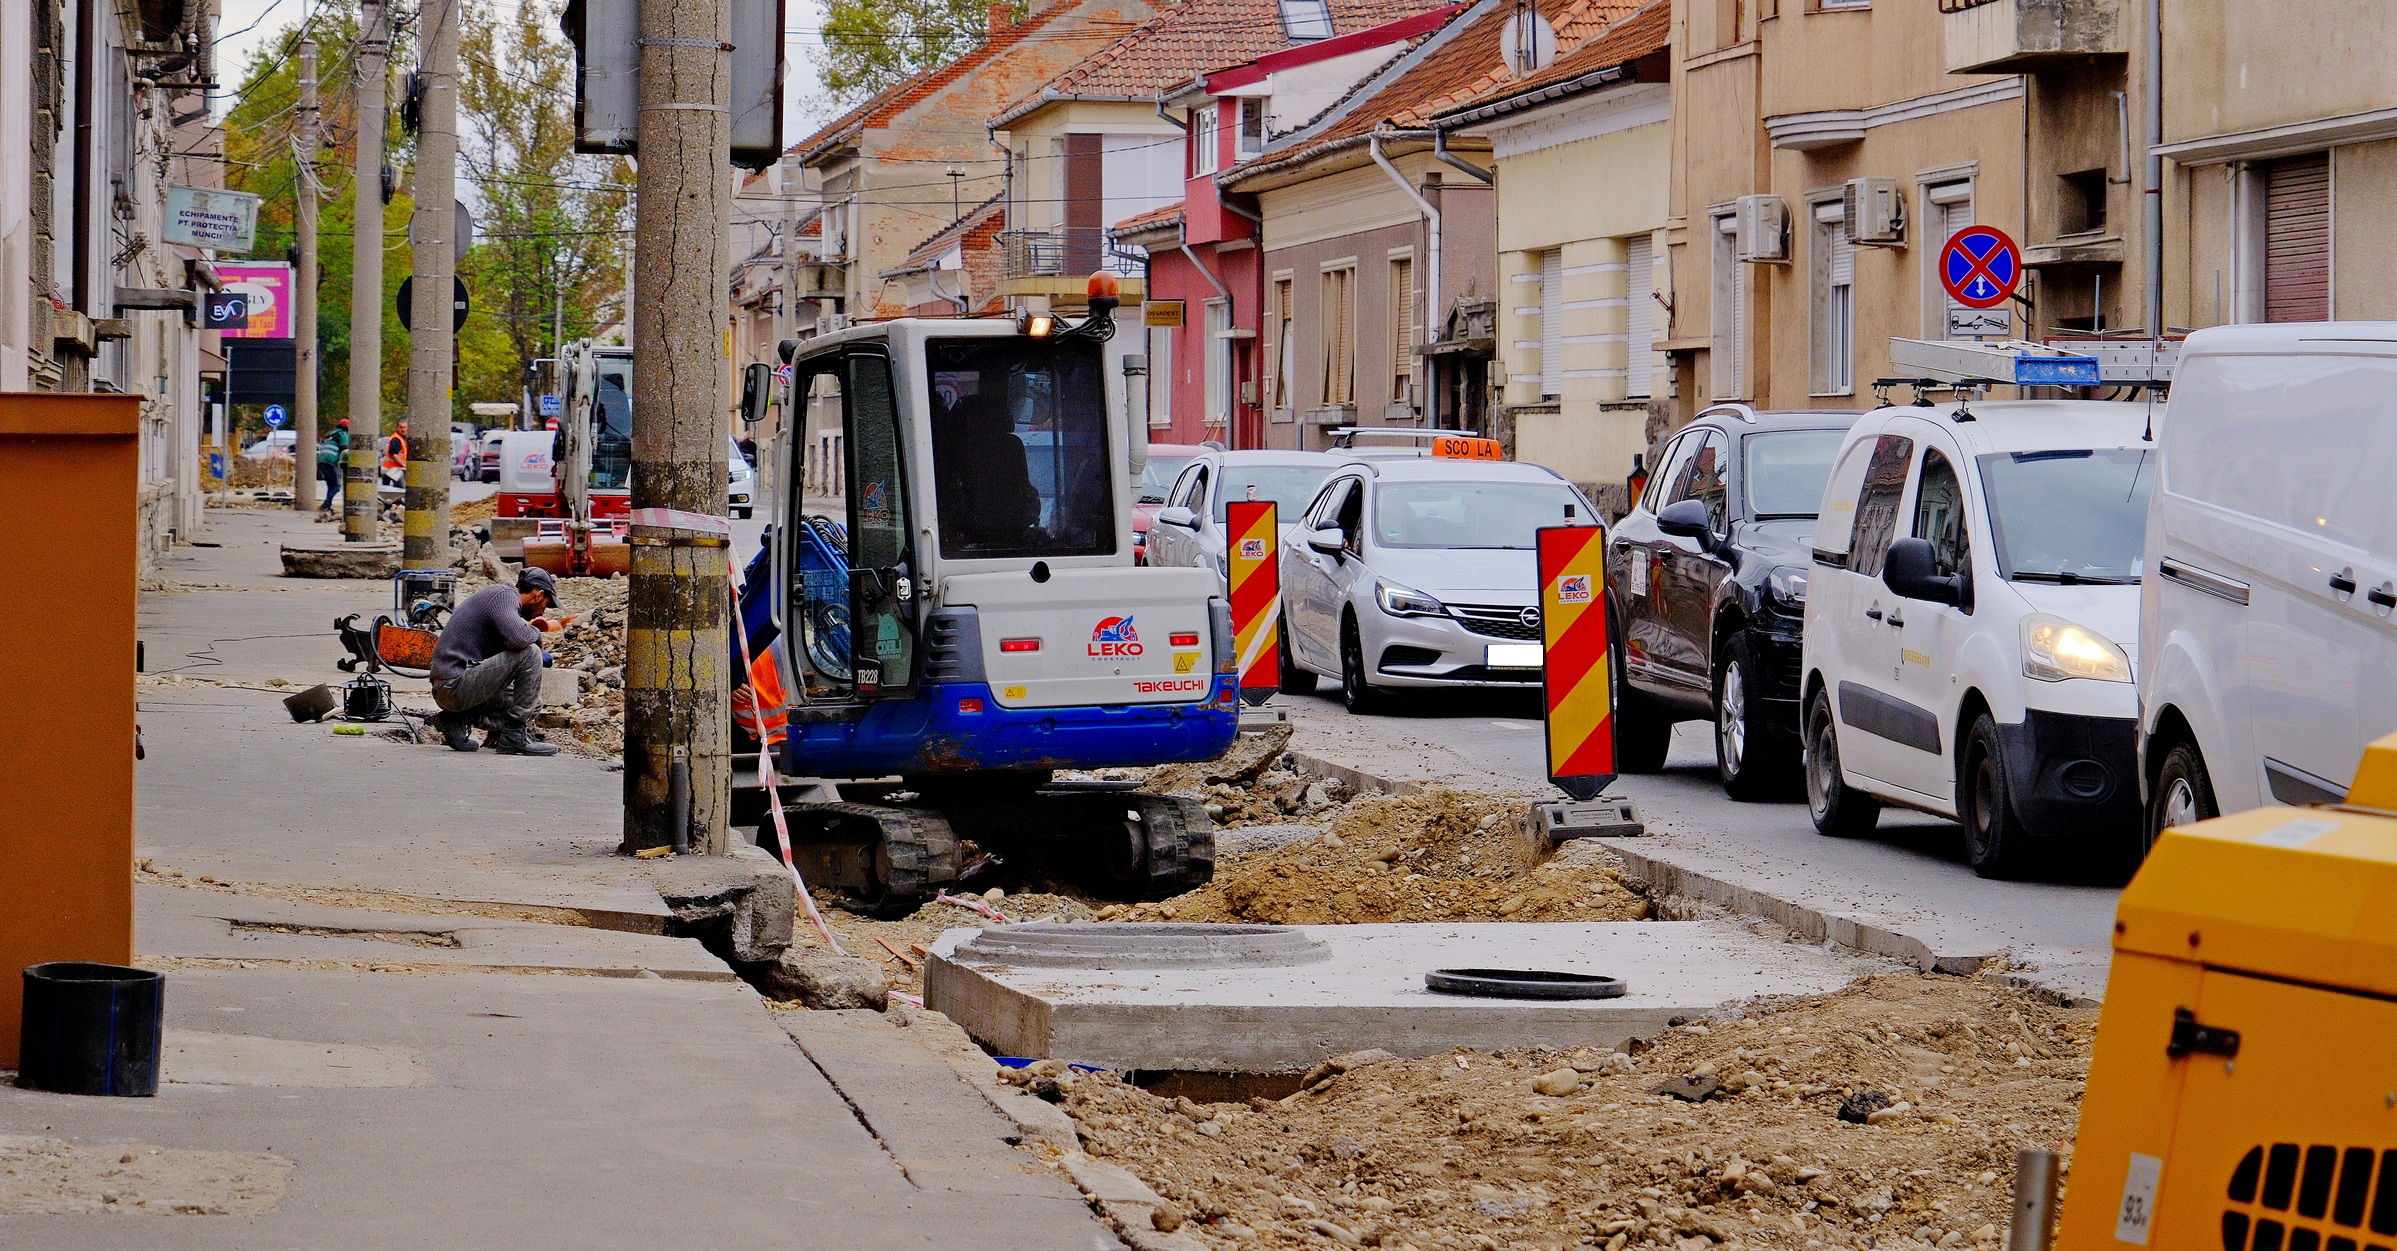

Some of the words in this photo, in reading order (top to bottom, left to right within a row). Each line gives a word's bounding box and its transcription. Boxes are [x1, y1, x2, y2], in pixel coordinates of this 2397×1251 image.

[179, 210, 239, 223] ECHIPAMENTE
[191, 221, 238, 232] PROTECTIA
[191, 230, 222, 239] MUNCII
[1445, 439, 1470, 456] SCO
[1477, 441, 1493, 457] LA
[1557, 591, 1590, 600] LEKO
[1087, 643, 1144, 656] LEKO
[857, 669, 879, 684] TB228
